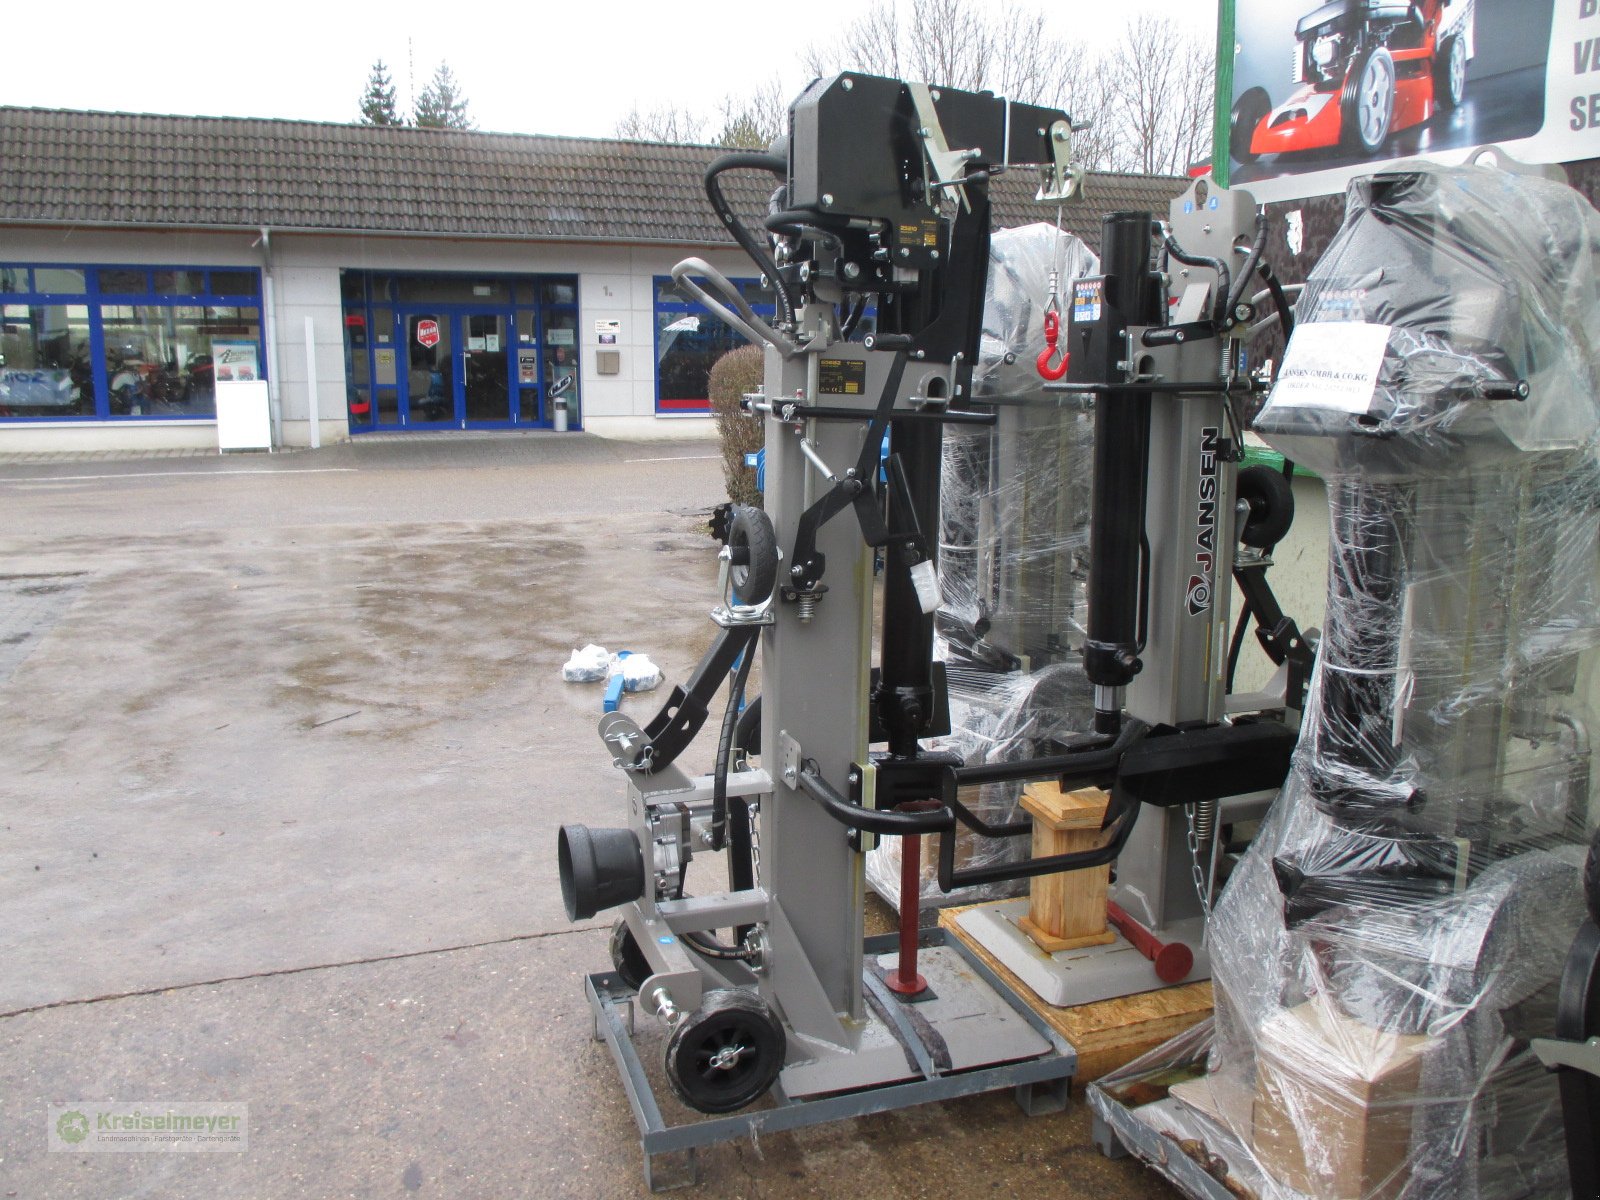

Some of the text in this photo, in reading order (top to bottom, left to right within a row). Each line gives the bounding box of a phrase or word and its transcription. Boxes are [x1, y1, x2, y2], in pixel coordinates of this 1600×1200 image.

[1579, 0, 1600, 20] B
[1570, 93, 1600, 132] SE
[1196, 426, 1218, 573] JANSEN
